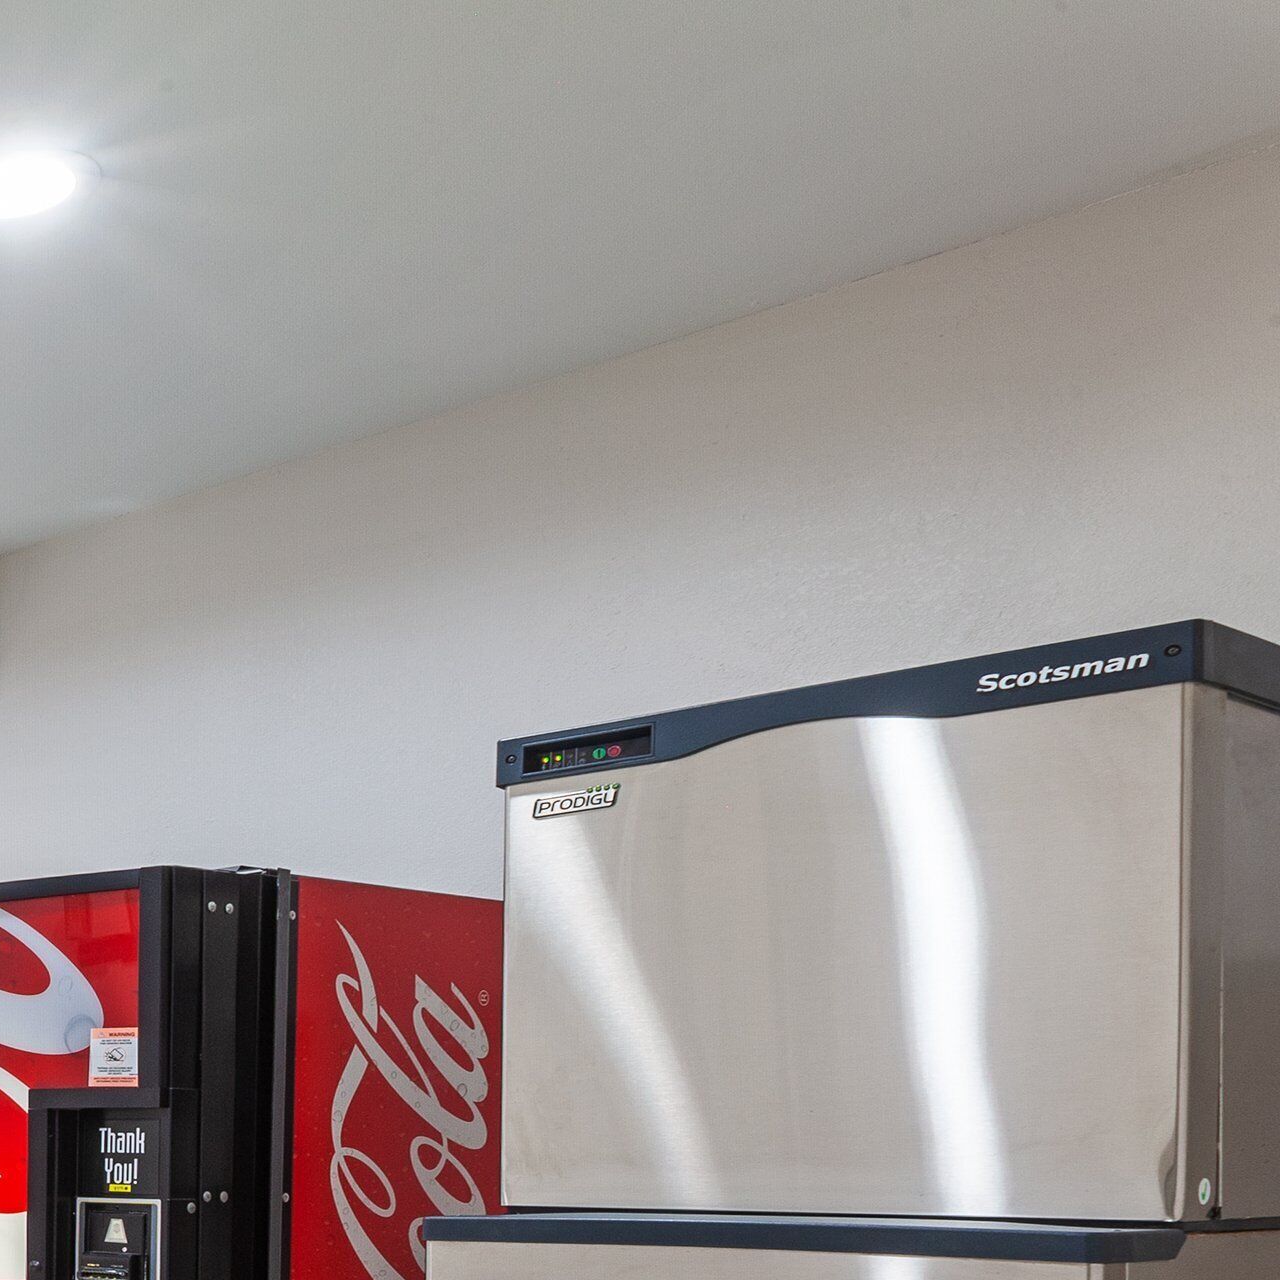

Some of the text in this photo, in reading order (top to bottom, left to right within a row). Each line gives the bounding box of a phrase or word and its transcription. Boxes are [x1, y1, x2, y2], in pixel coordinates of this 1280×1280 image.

[976, 652, 1150, 693] Scotsman
[99, 1127, 146, 1154] Thank
[104, 1157, 138, 1185] You!
